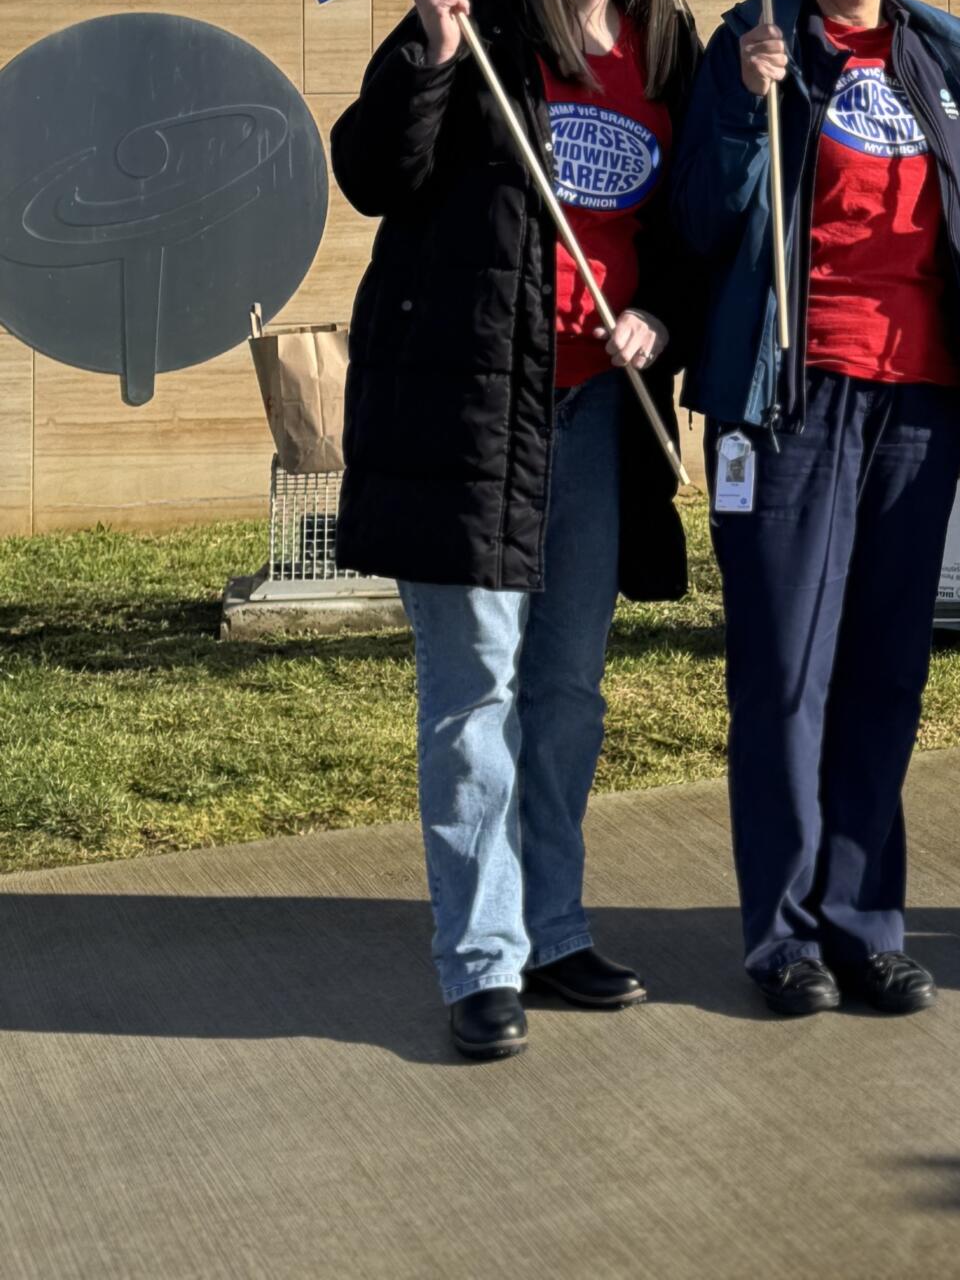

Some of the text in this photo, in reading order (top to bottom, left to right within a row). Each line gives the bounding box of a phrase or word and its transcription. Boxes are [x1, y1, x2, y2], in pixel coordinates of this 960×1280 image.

[836, 82, 901, 117] NURS
[578, 106, 598, 117] VIC
[600, 111, 653, 142] BRANCH
[836, 114, 916, 142] MIDWIV
[864, 143, 883, 154] MY
[556, 187, 617, 208] MY UNION
